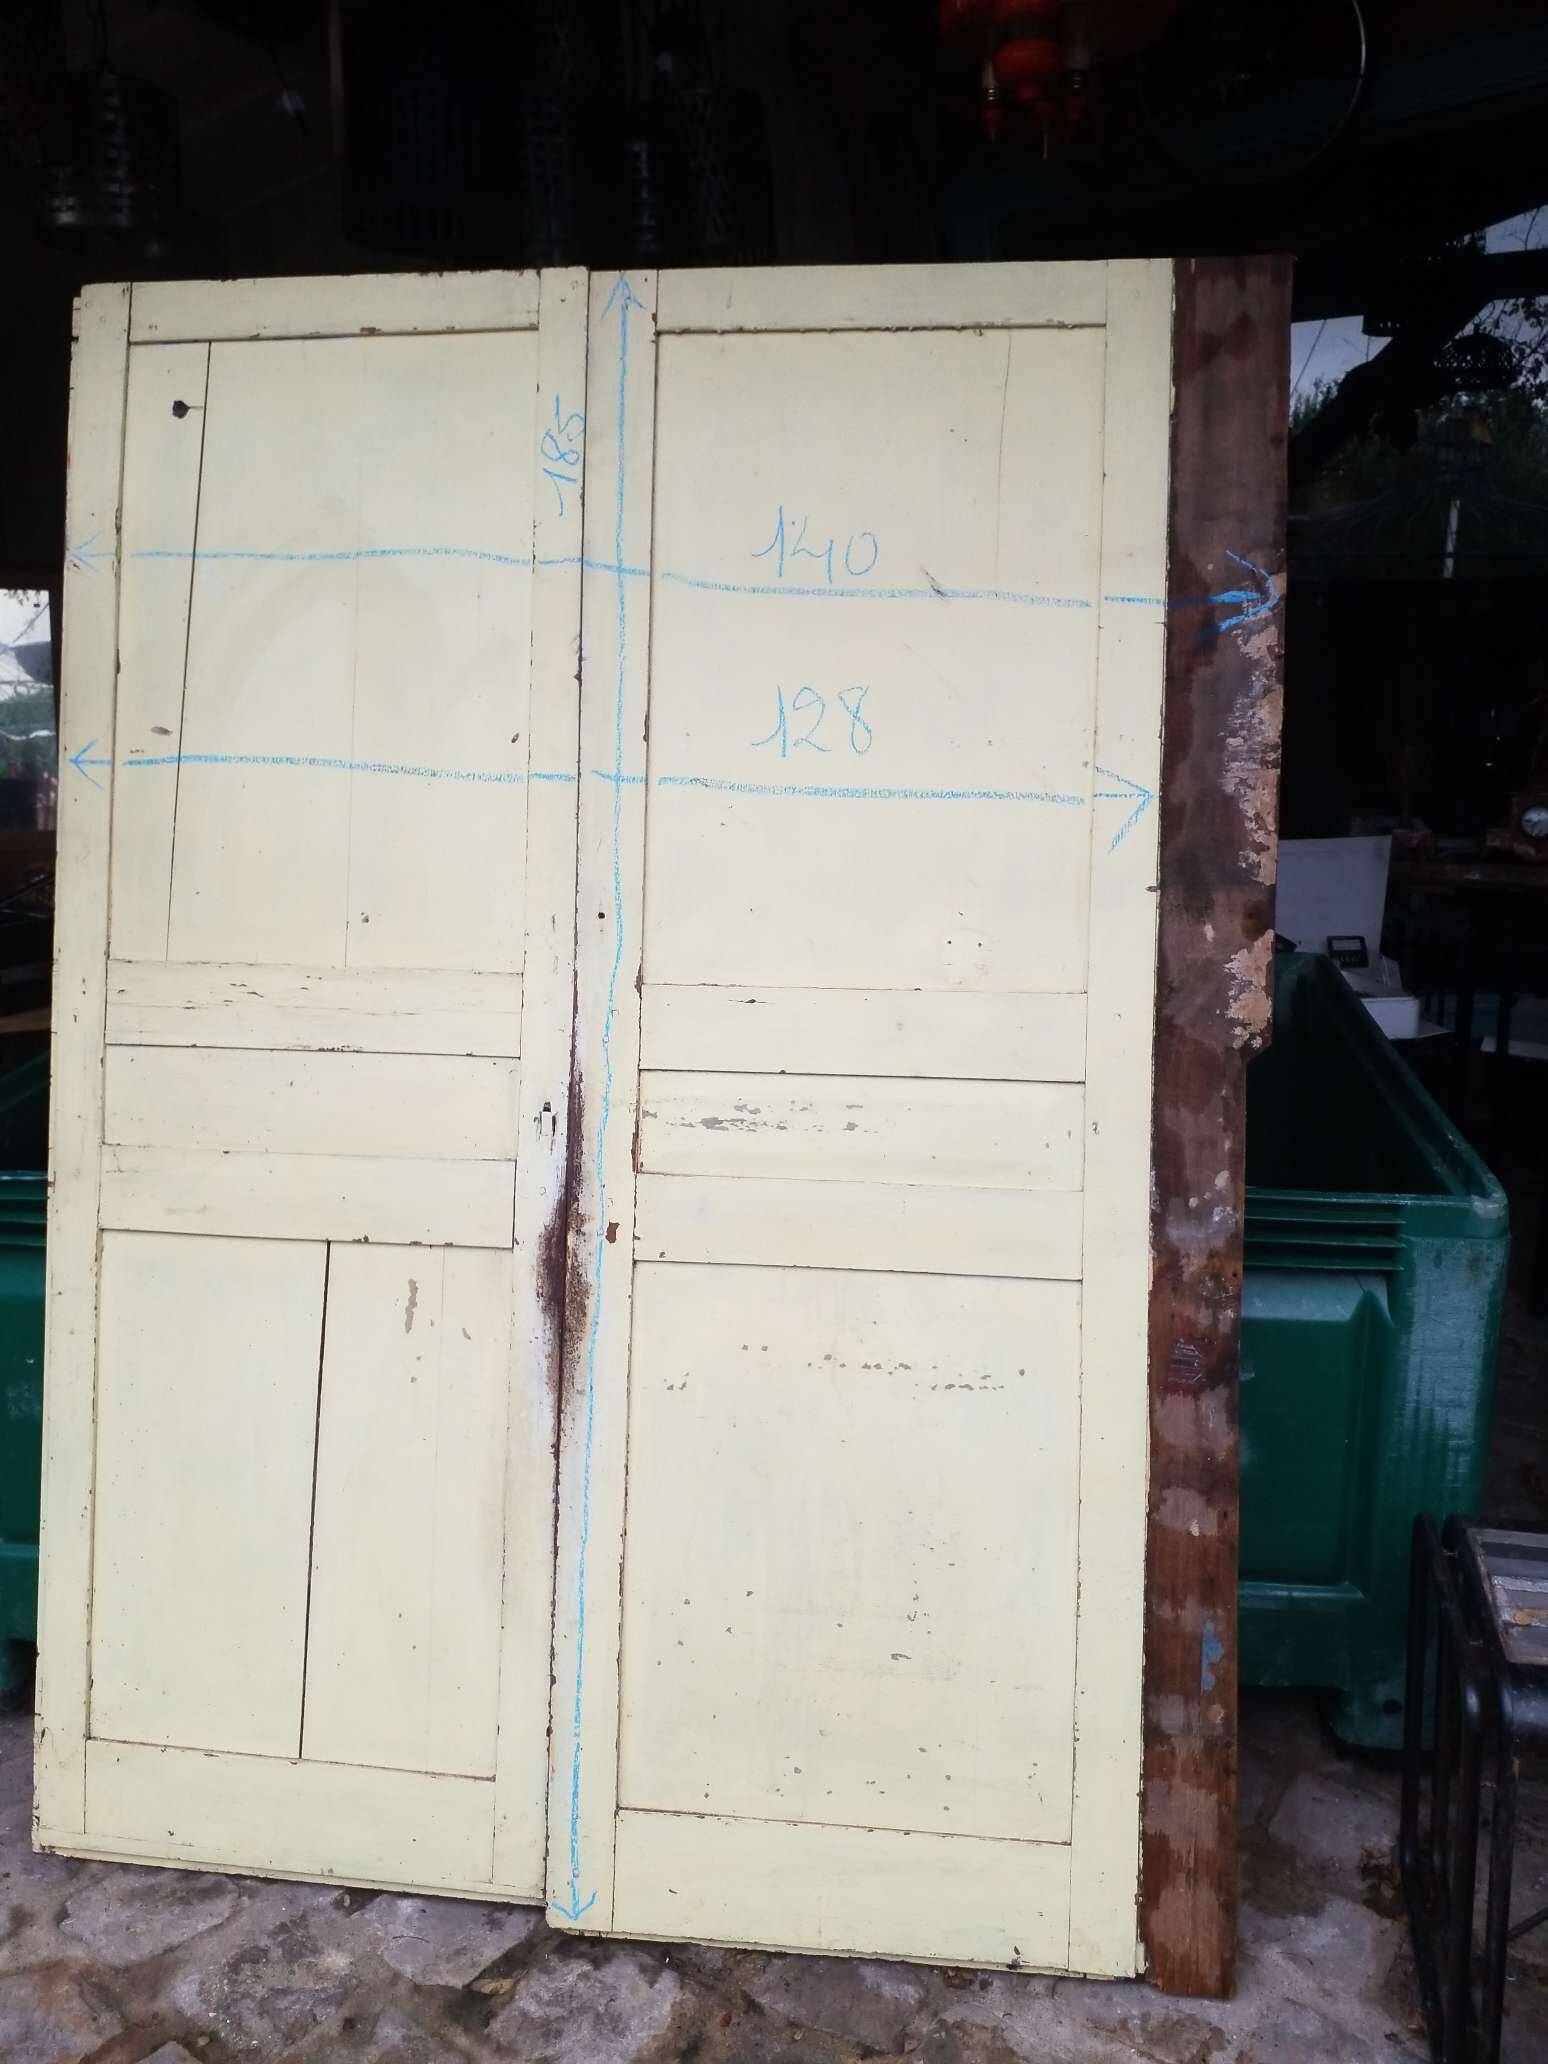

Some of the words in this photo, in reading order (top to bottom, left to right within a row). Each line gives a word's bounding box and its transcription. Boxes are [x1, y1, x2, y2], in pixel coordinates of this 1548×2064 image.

[541, 392, 587, 516] 185
[752, 506, 878, 583] 140
[752, 685, 873, 757] 128
